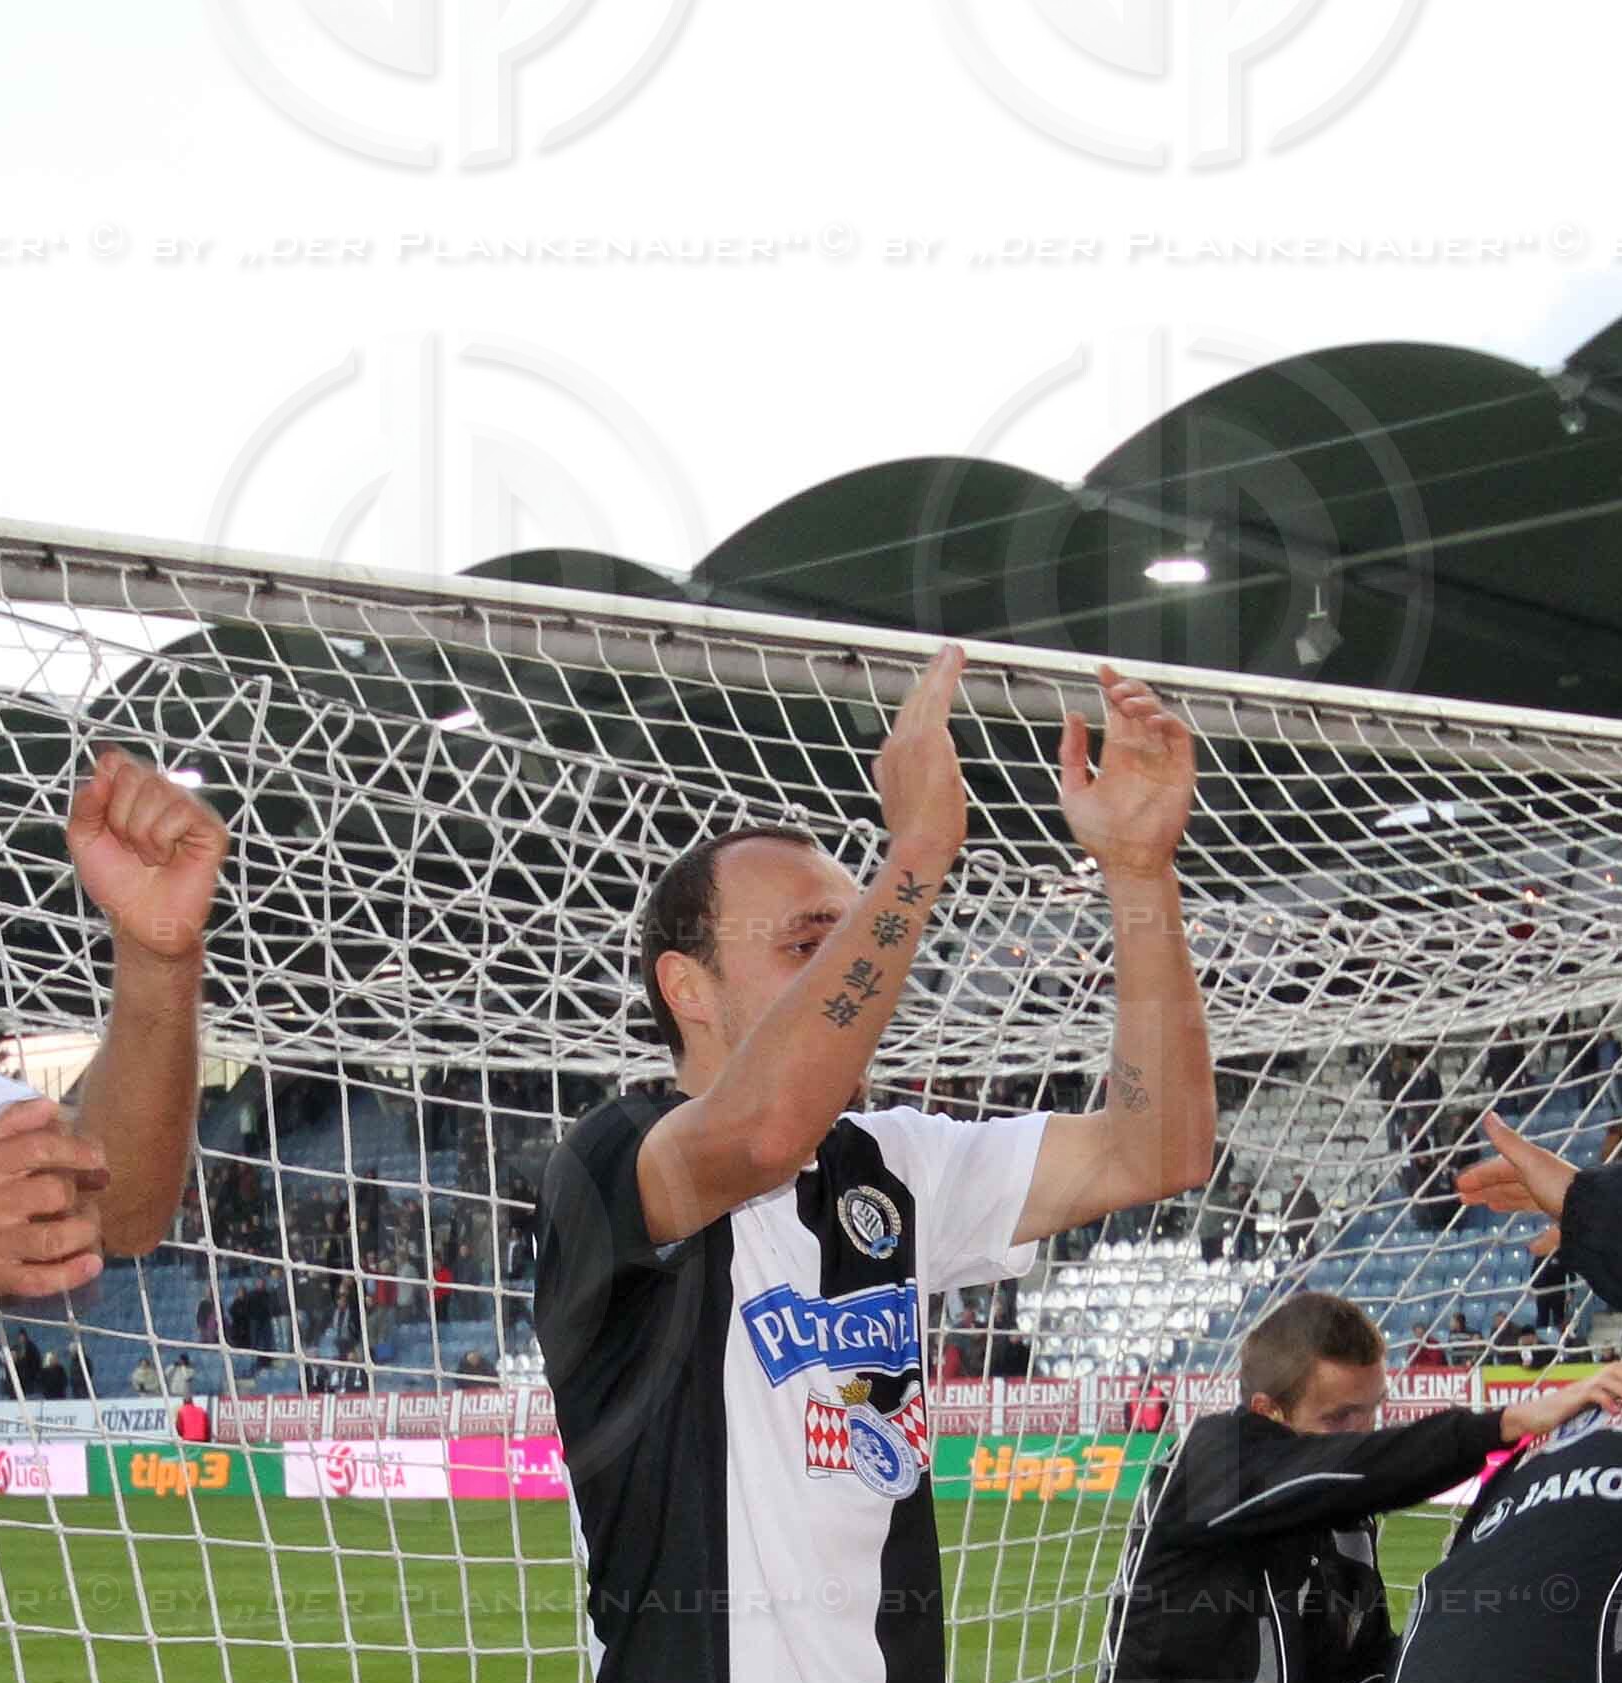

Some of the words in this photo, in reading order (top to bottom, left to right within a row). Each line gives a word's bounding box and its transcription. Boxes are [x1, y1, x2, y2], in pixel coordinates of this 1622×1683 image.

[1007, 1382, 1076, 1404] KLEINE
[1387, 1376, 1466, 1400] KLEINE
[399, 1398, 450, 1419] KLEINE
[131, 1452, 230, 1496] tipp3
[970, 1446, 1124, 1501] tipp3
